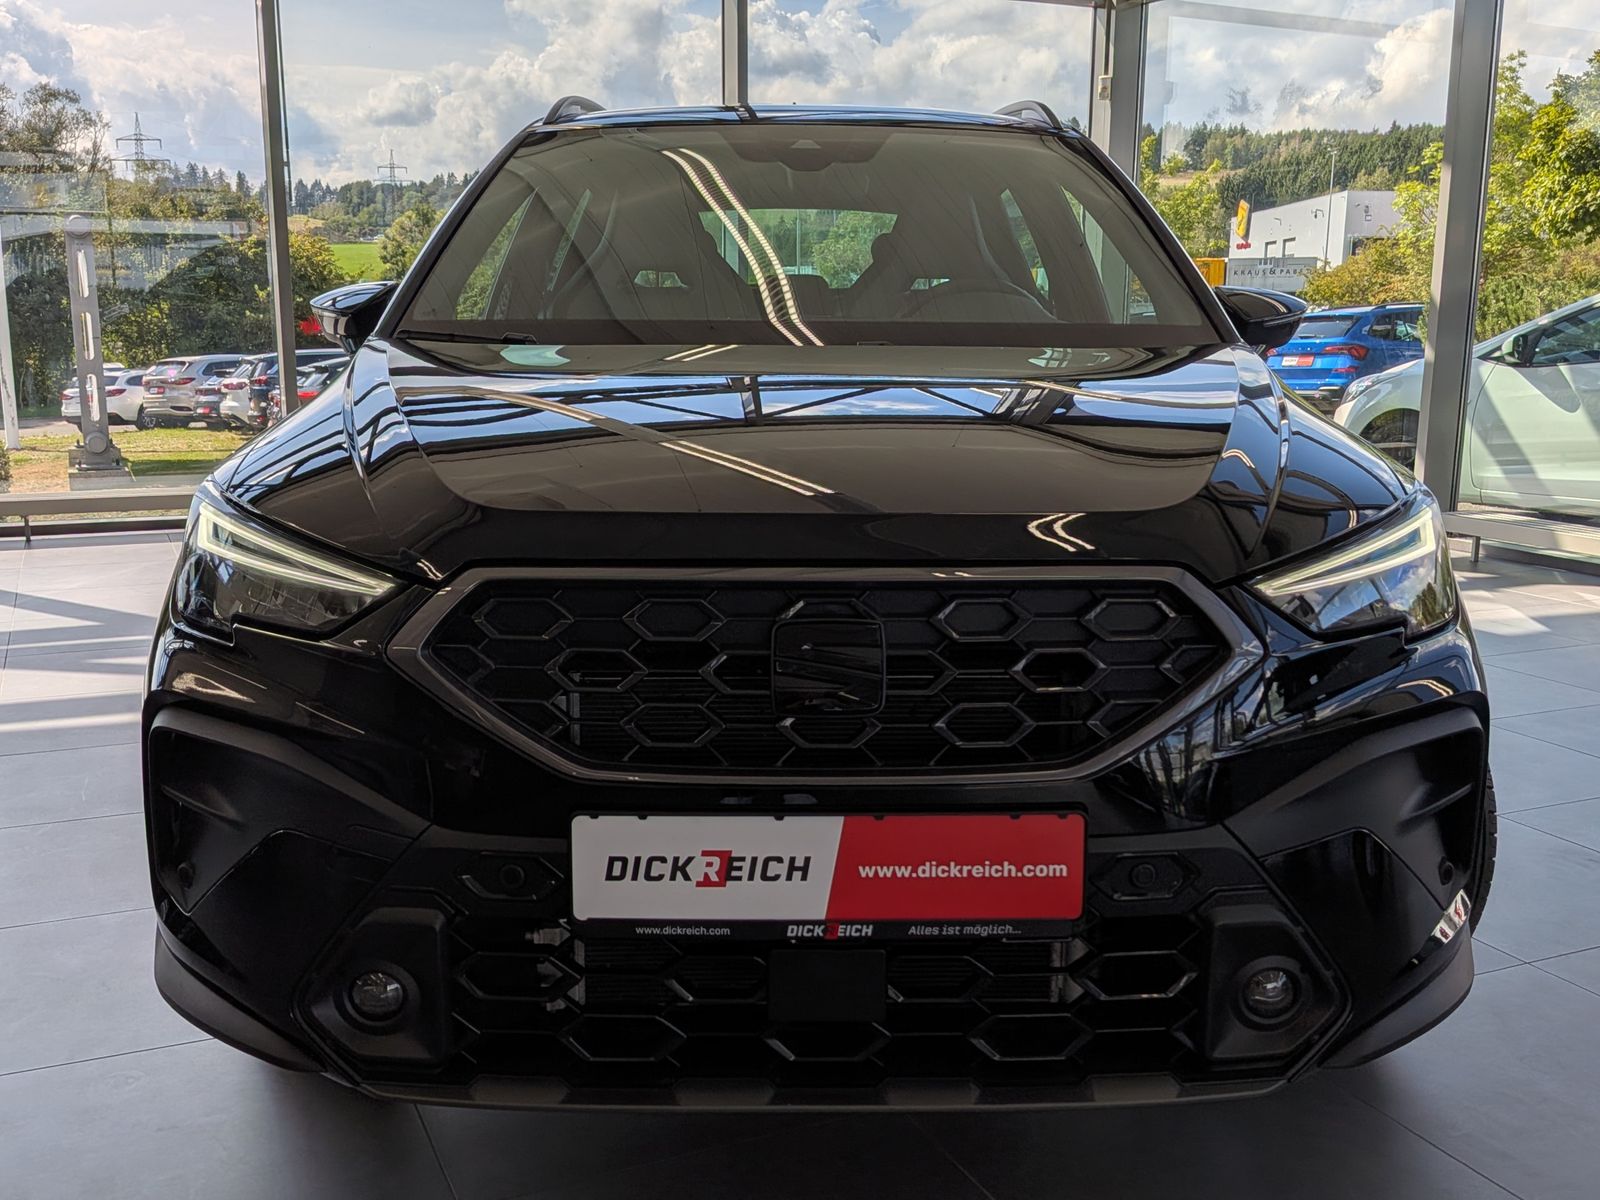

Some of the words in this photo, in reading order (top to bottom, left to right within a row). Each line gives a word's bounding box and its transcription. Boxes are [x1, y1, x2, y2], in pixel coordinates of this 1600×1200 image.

[604, 855, 812, 882] DICKREICH
[858, 861, 1068, 878] www.dickreich.com
[635, 925, 731, 936] www.dickreich.com
[908, 924, 940, 936] Alles
[941, 923, 960, 936] ist
[963, 923, 1022, 937] möglich...
